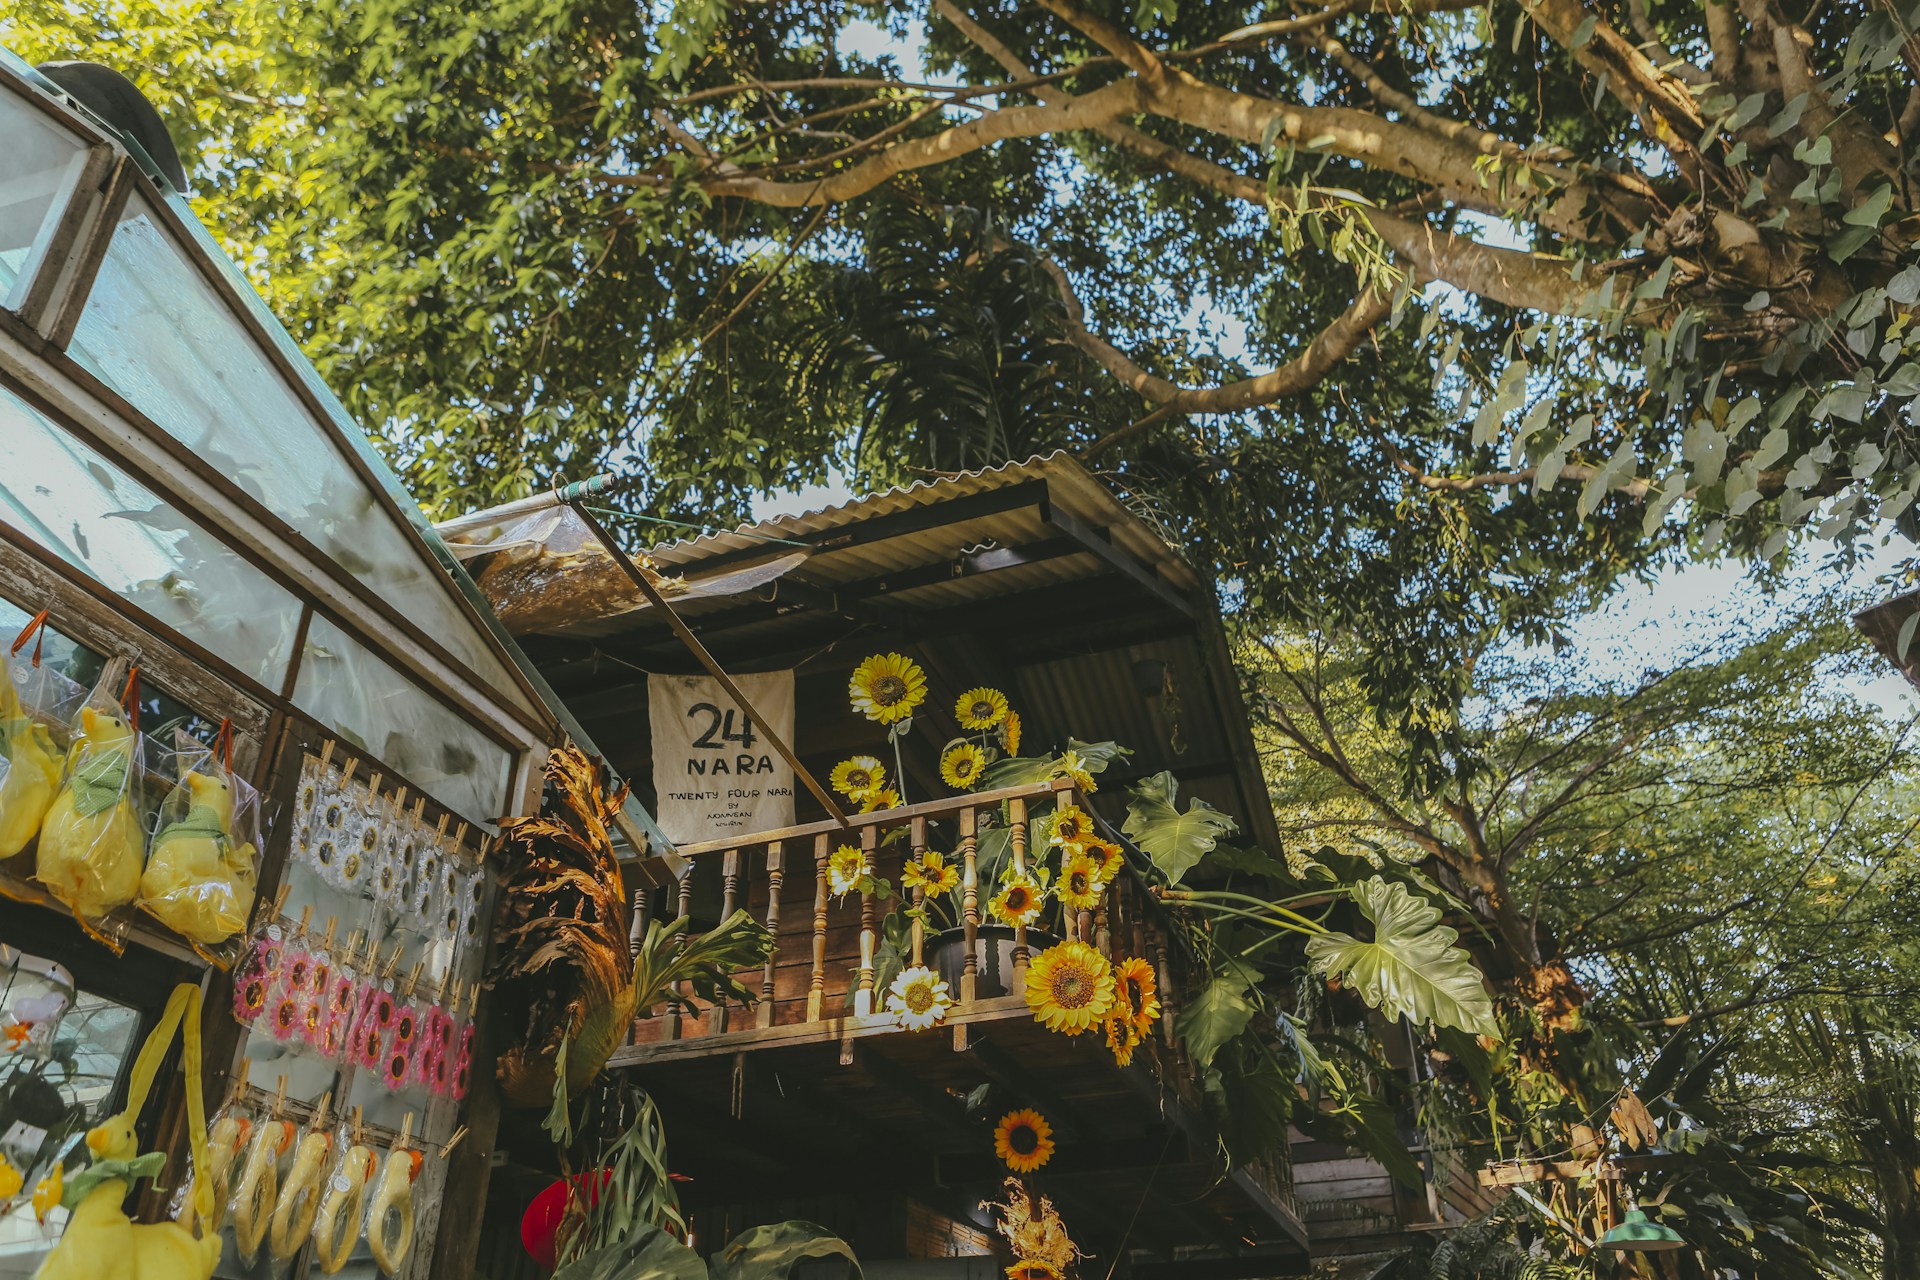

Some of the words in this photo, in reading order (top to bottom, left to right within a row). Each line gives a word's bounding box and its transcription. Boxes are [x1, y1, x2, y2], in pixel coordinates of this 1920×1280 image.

[687, 702, 758, 749] 24
[687, 754, 775, 776] NARA
[668, 791, 719, 800] TWENTY
[728, 789, 760, 798] FOUR
[767, 788, 793, 797] NARA
[728, 802, 739, 810] BY
